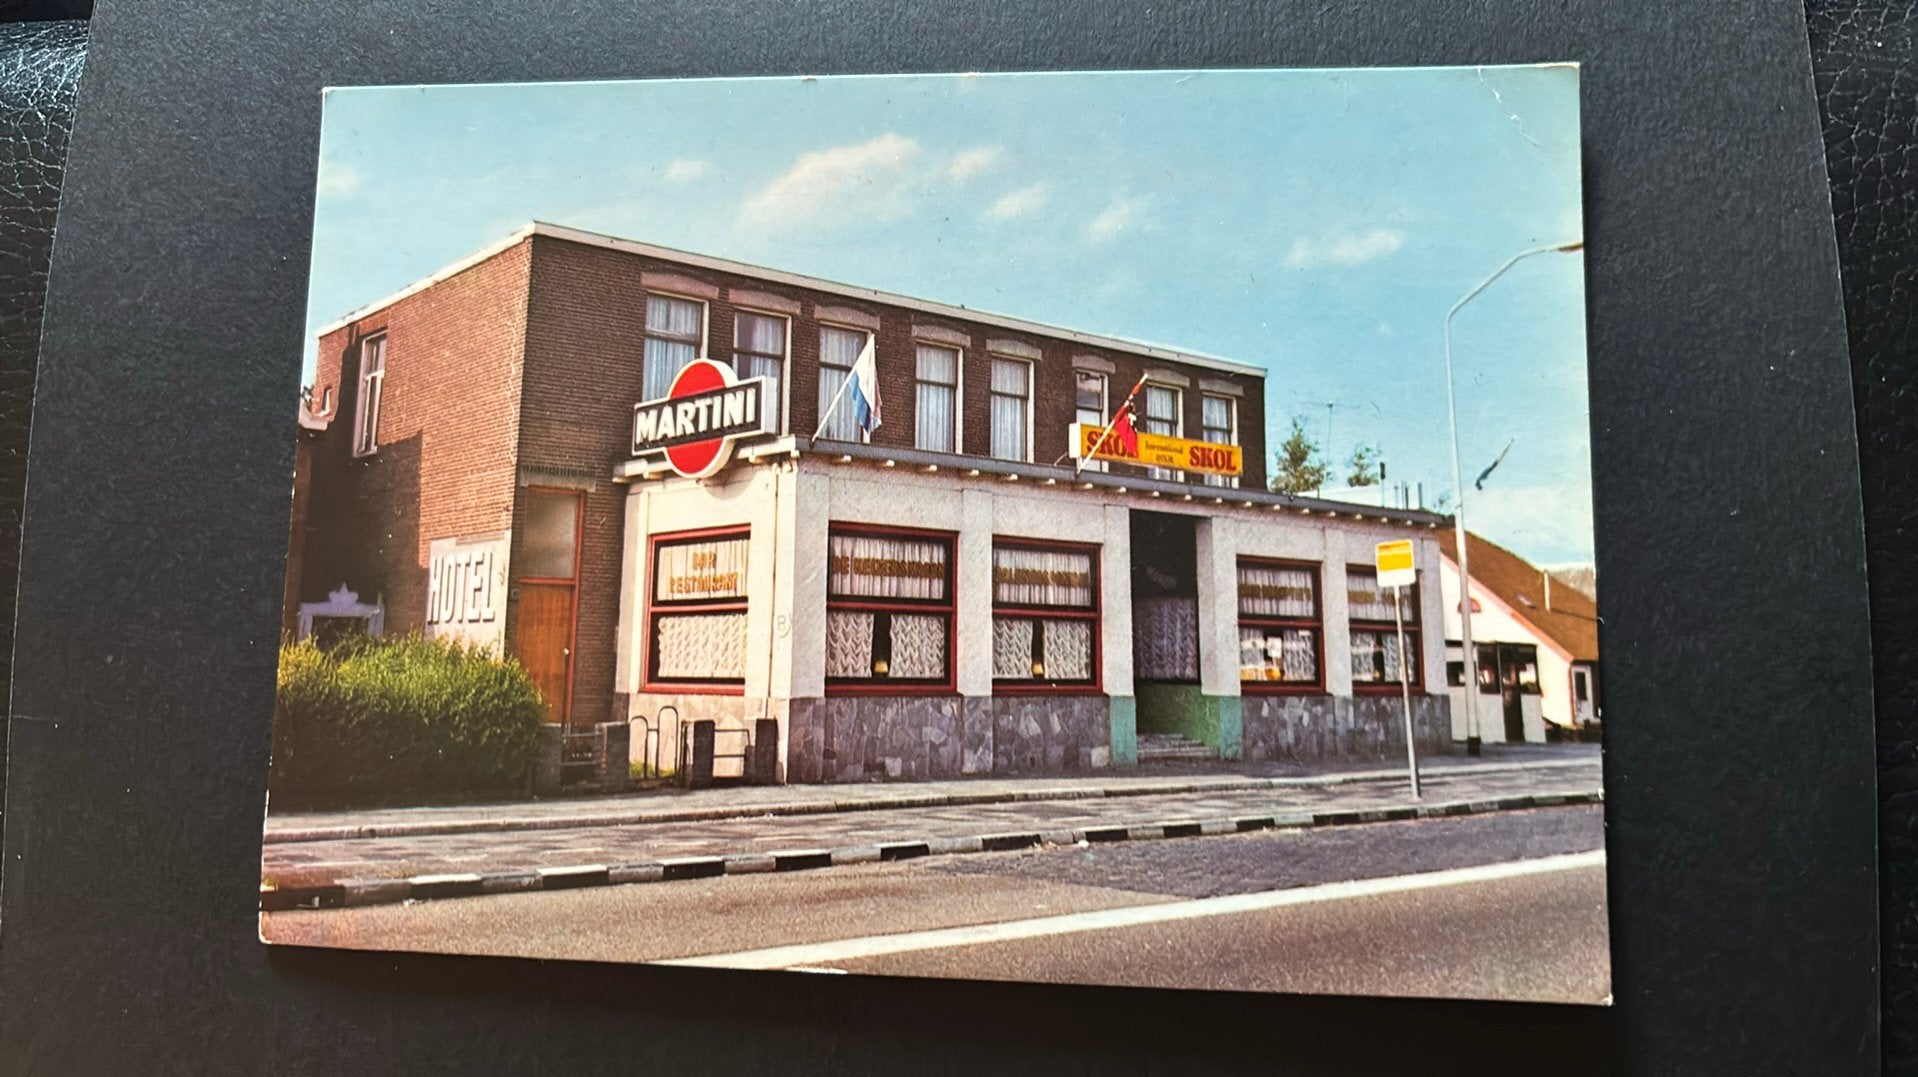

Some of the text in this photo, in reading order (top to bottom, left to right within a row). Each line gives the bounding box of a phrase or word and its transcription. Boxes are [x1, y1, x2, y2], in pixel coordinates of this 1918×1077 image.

[636, 388, 756, 445] MARTINI
[1189, 445, 1236, 471] SKOL
[427, 551, 495, 626] HOTEL
[669, 572, 738, 593] RESTAURANT
